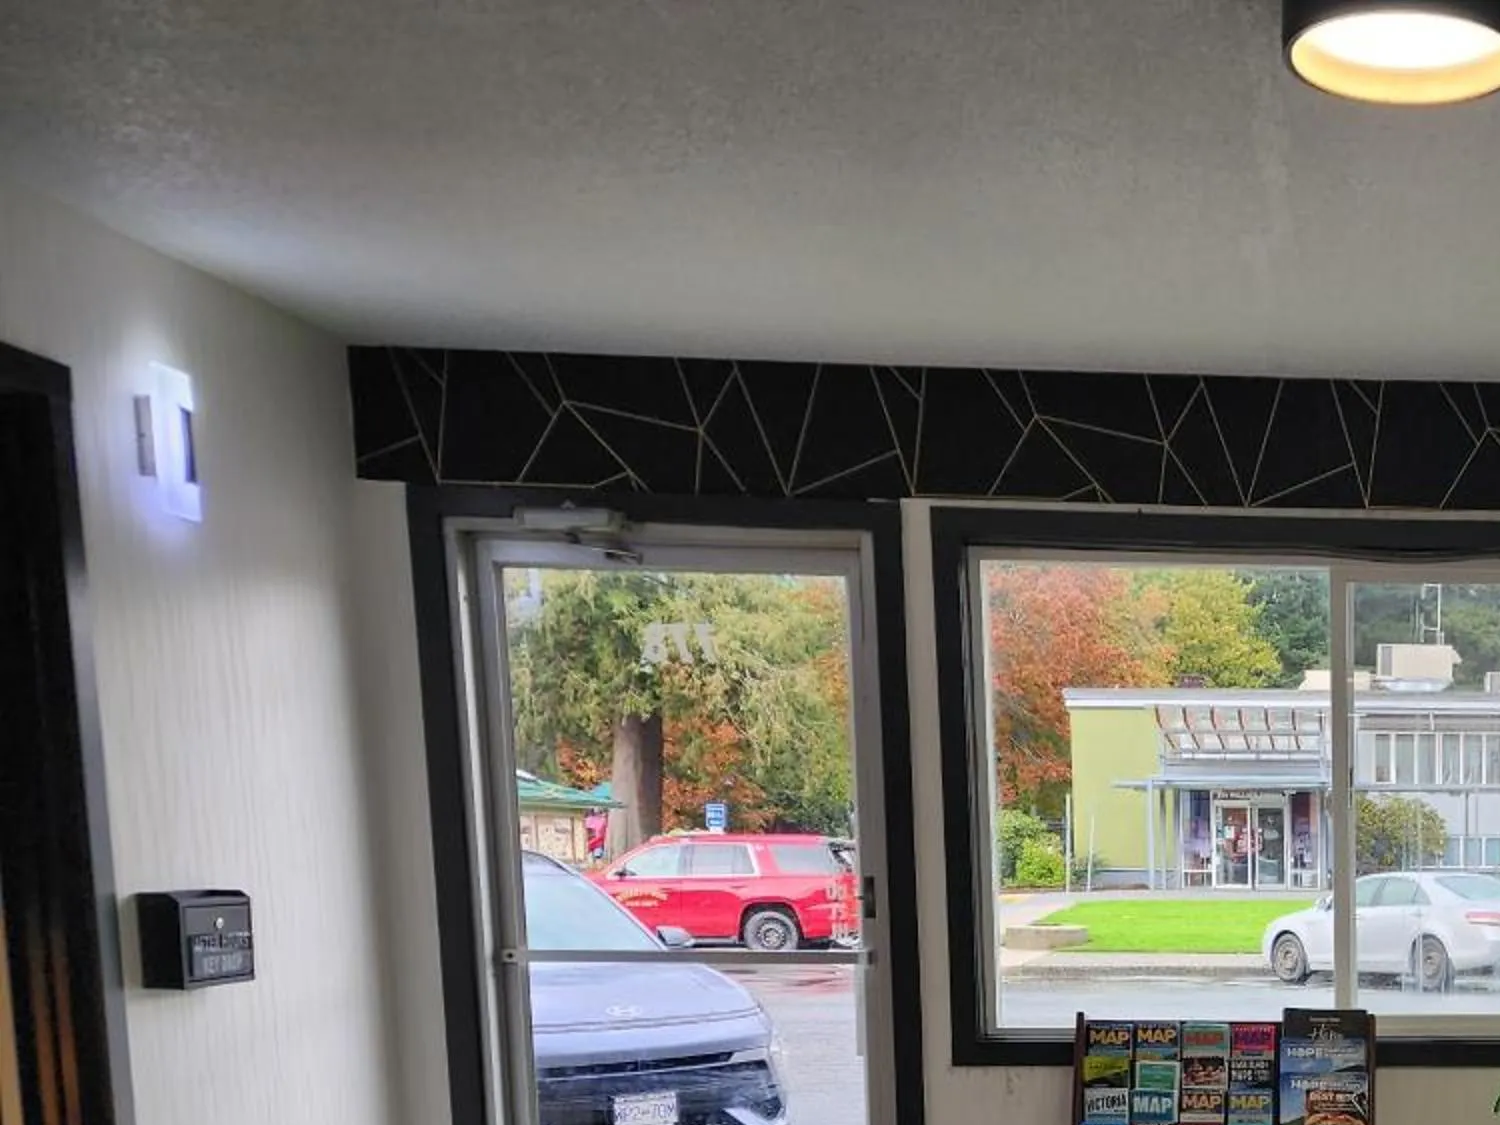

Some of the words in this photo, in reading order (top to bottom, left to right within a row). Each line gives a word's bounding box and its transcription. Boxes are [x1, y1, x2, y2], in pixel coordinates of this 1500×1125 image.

[1089, 1029, 1129, 1044] MAP
[1137, 1028, 1176, 1043] MAP
[1133, 1095, 1172, 1113] MAP
[1183, 1094, 1221, 1109] MAP
